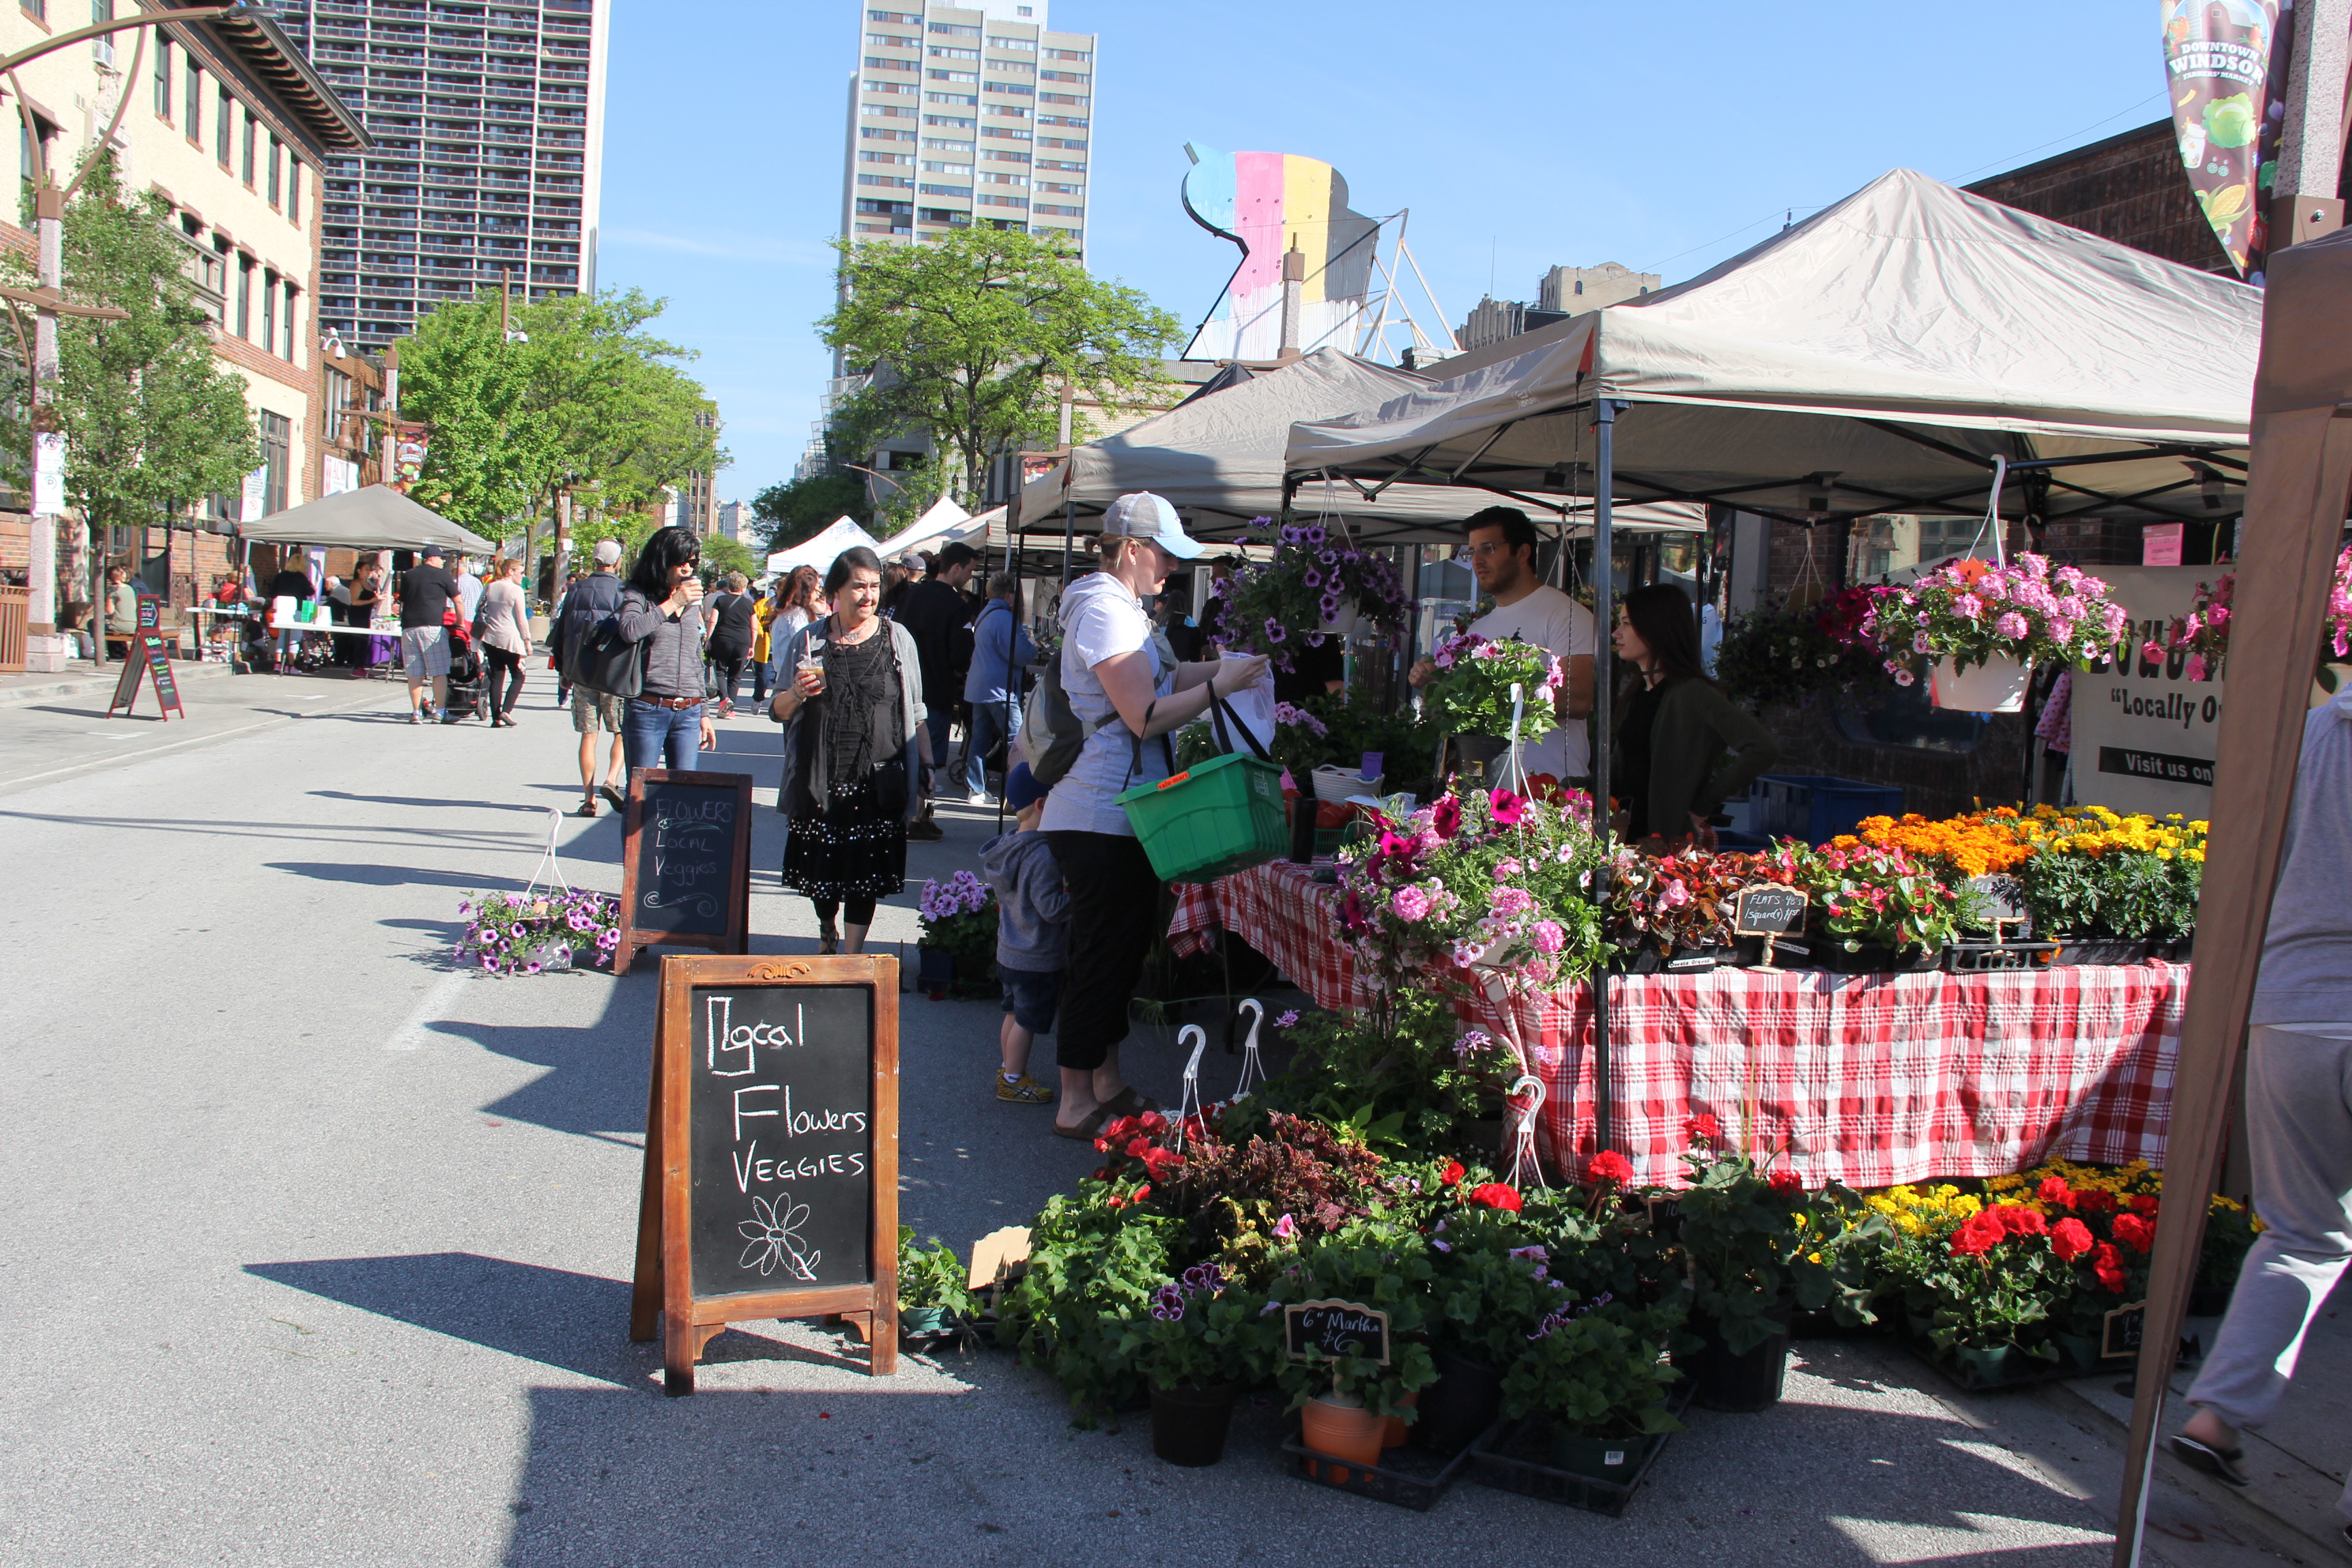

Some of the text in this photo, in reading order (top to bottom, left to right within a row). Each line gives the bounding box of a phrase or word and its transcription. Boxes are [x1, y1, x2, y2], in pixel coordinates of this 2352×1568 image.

[2180, 42, 2259, 62] DOWNTOWN
[2168, 53, 2264, 85] WINDSOR
[2182, 71, 2255, 86] FARMERS' MARKET
[2201, 695, 2221, 723] O
[2125, 753, 2163, 774] Visit
[2168, 762, 2187, 777] us
[1158, 772, 1189, 789] valu-mart
[656, 799, 734, 822] FLOWERS
[655, 855, 717, 885] Veggies
[706, 995, 804, 1077] Local
[733, 1084, 867, 1141] Flowers
[732, 1139, 865, 1194] VEGGIES
[1327, 1312, 1382, 1332] Martha
